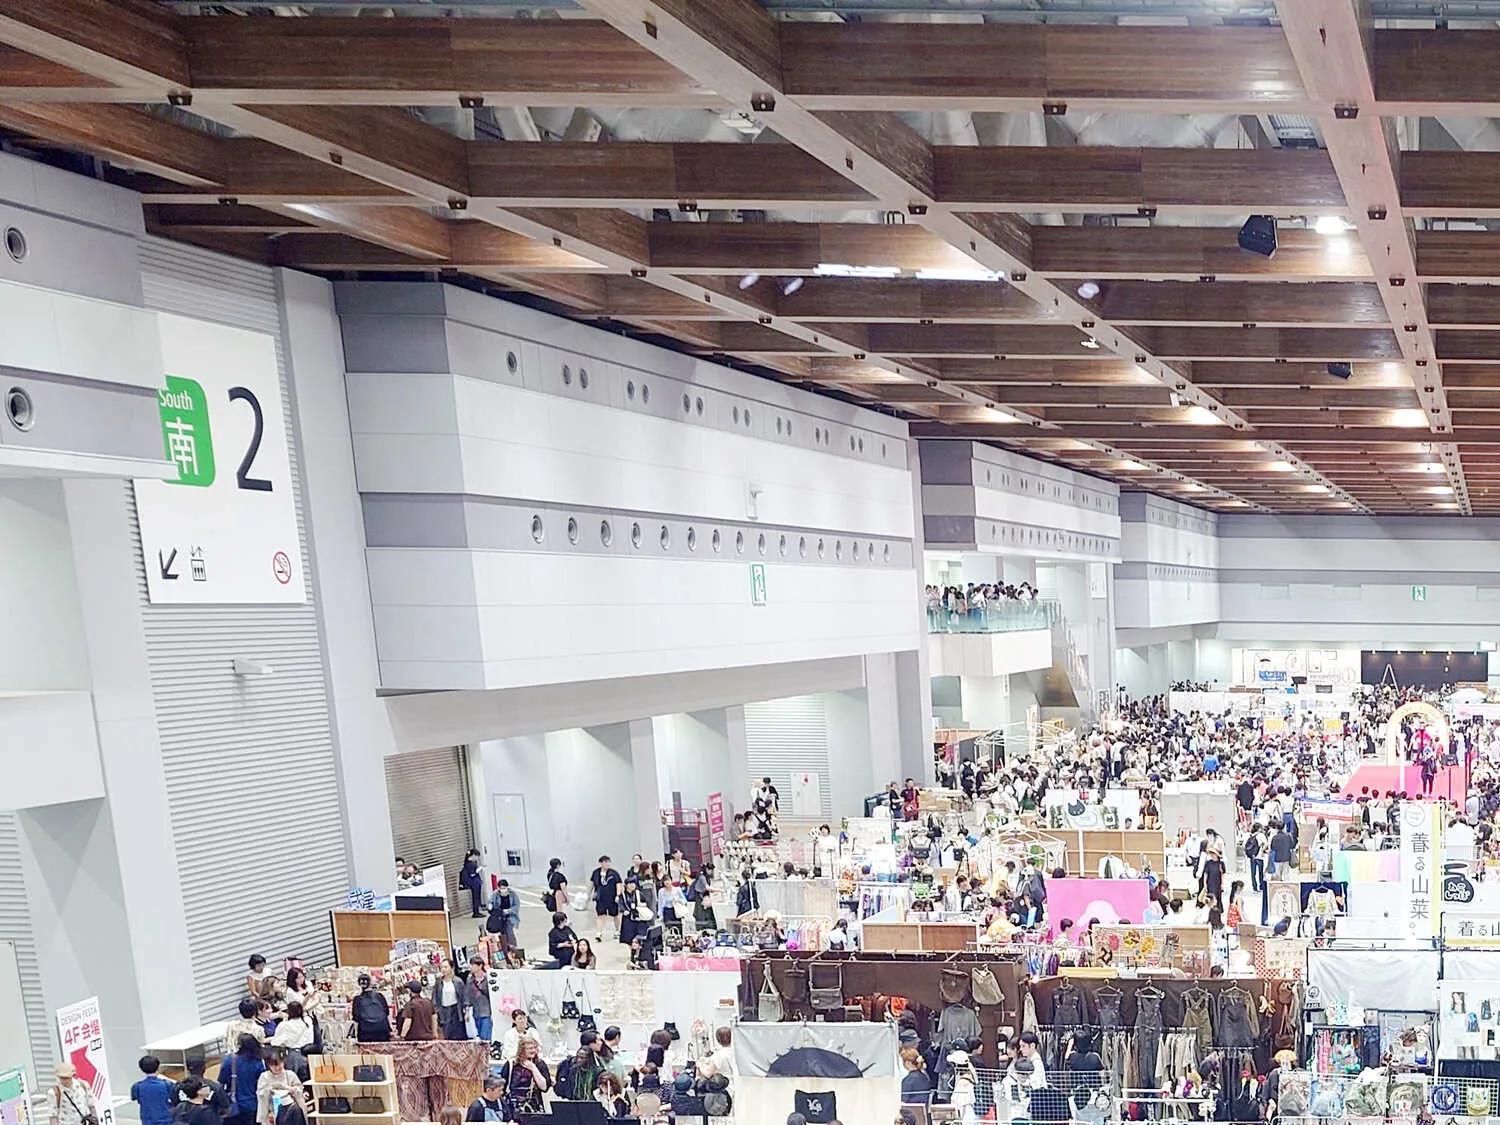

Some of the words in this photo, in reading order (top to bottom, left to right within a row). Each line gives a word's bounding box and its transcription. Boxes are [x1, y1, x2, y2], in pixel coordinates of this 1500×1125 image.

[159, 388, 193, 411] South
[165, 416, 199, 476] 南
[228, 386, 273, 492] 2
